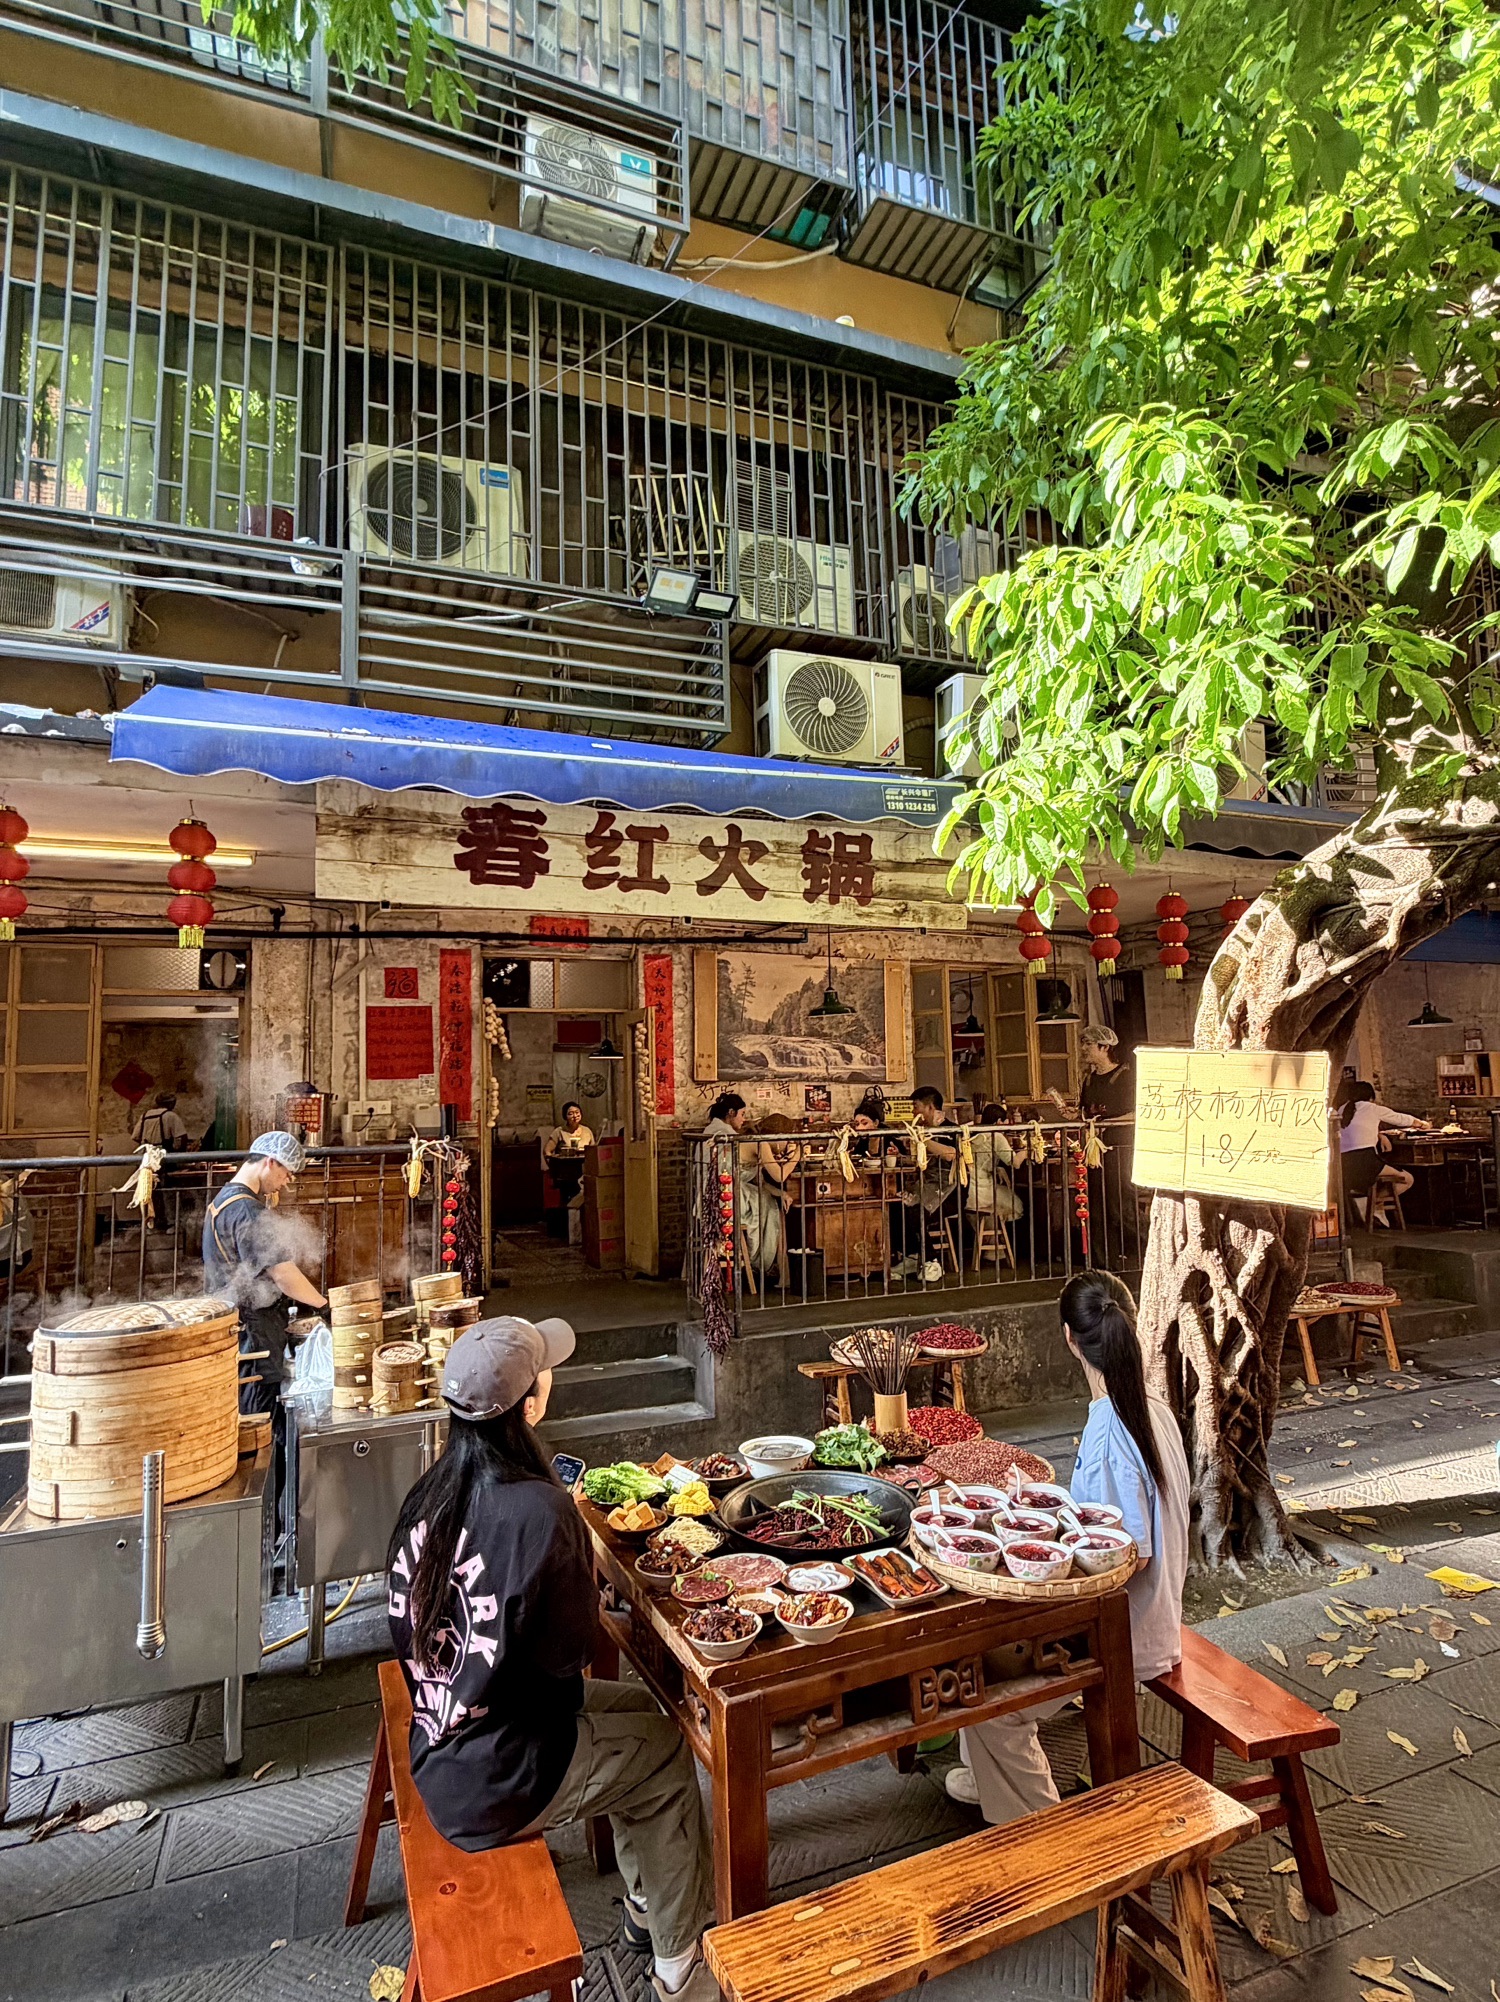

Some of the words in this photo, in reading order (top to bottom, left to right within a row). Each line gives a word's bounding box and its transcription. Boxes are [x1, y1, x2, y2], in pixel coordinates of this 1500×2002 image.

[887, 801, 904, 811] 1310
[905, 802, 922, 811] 1234
[453, 802, 876, 905] 春红火锅
[1139, 1082, 1324, 1133] 荔枝杨梅饮
[388, 1519, 499, 1669] GYMARK
